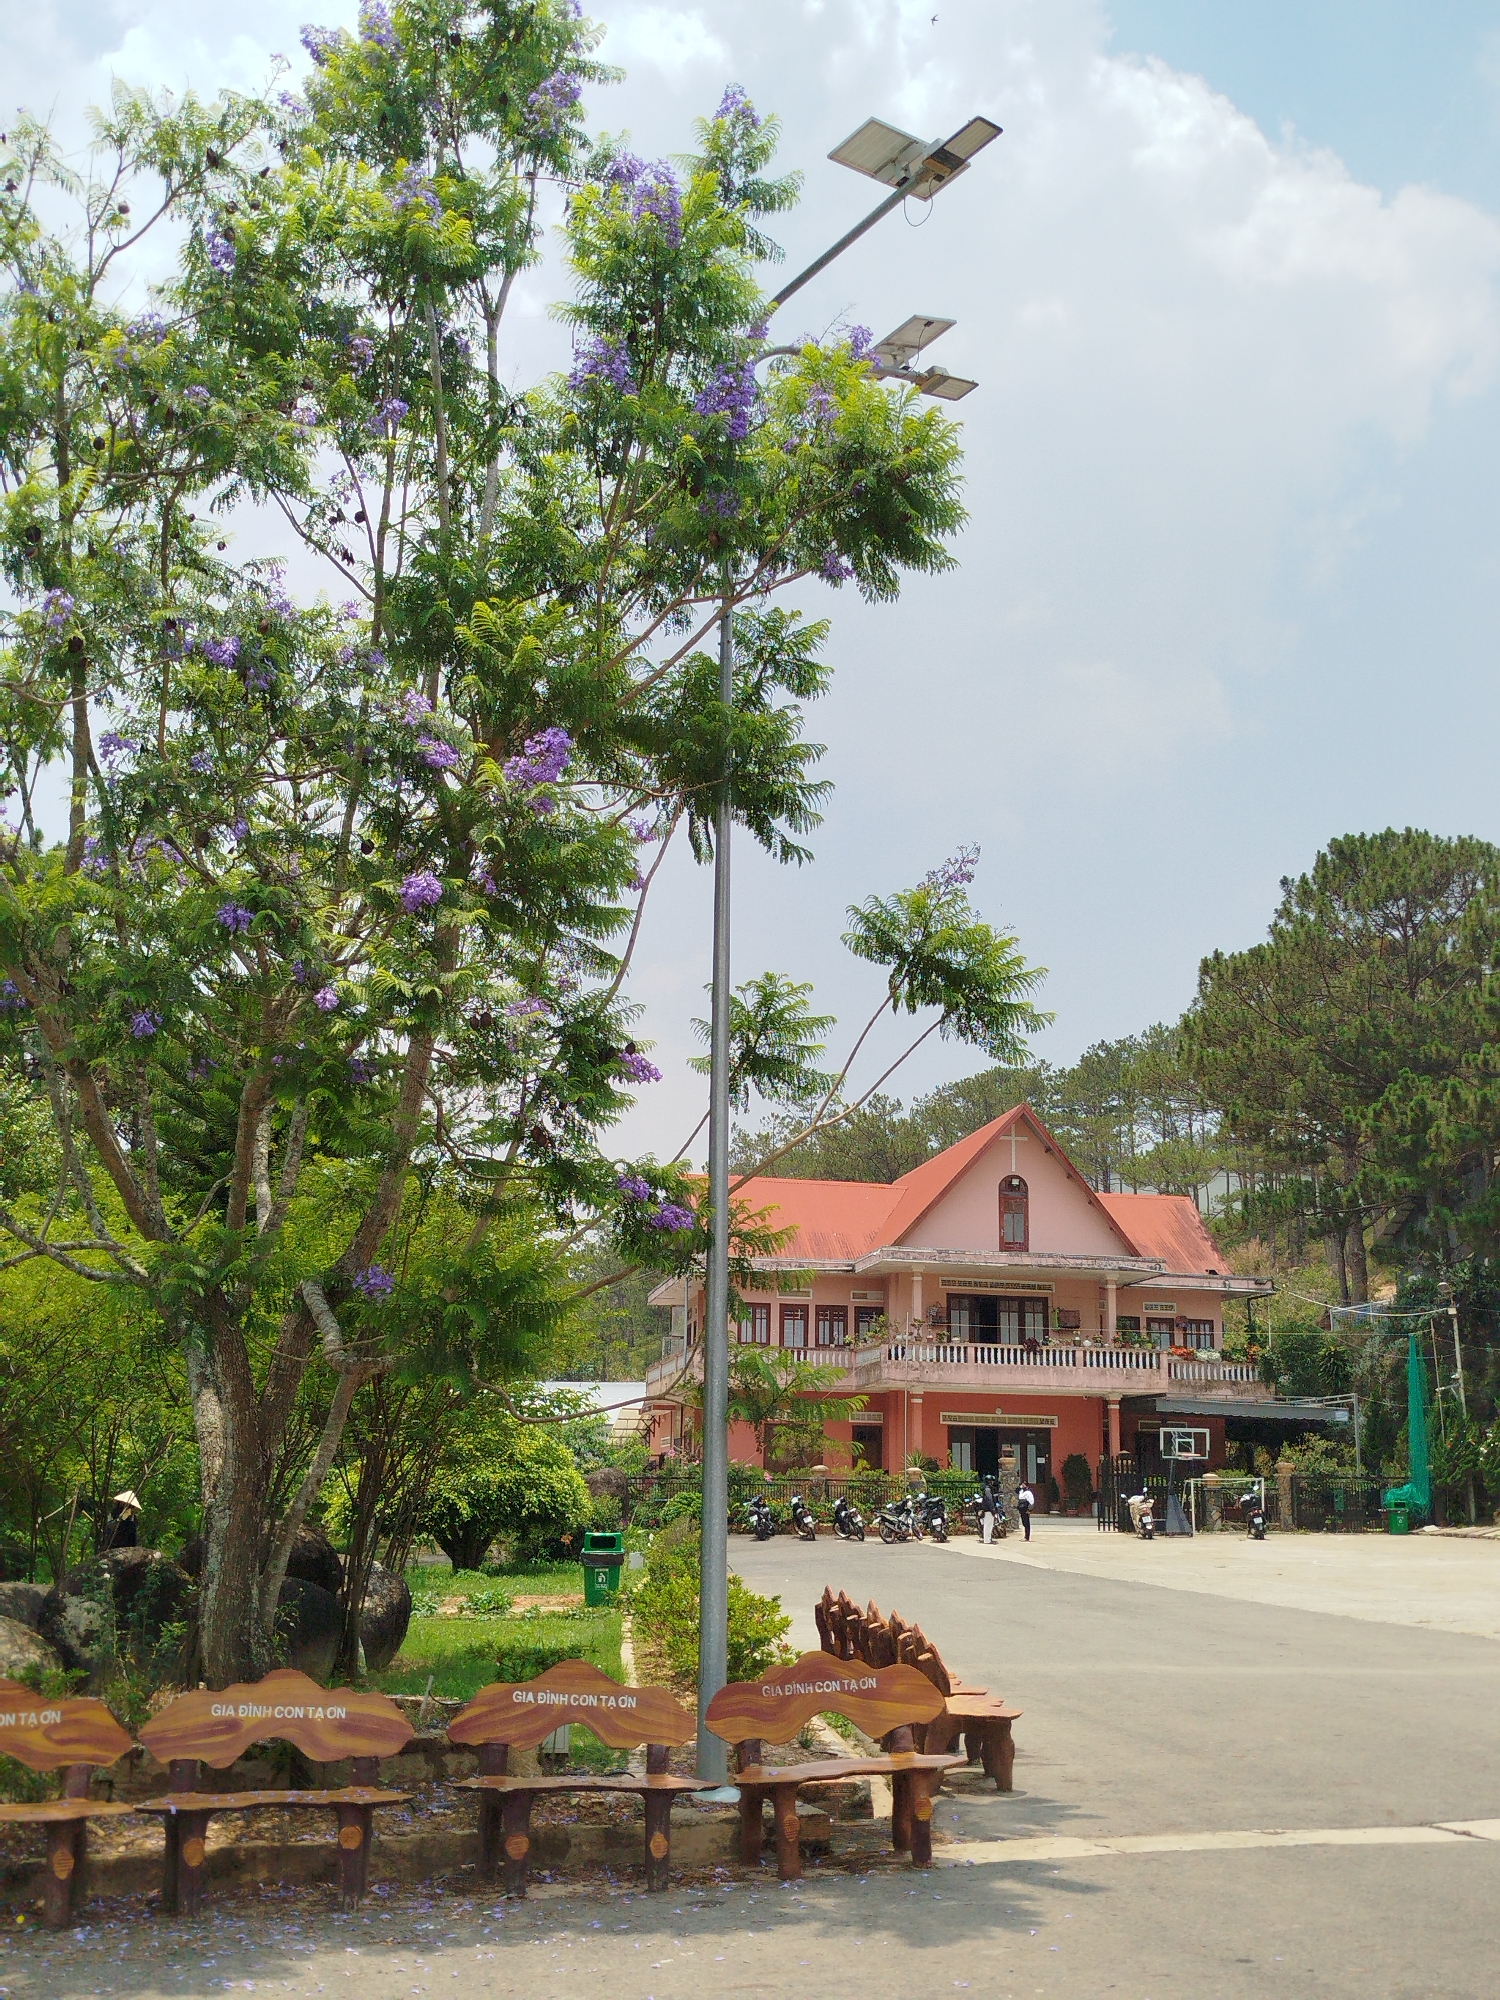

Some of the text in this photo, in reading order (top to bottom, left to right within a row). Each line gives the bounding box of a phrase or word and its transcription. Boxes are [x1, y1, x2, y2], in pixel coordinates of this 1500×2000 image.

[762, 1677, 877, 1697] GIA ĐÌNH CON TẠ ƠN
[512, 1690, 637, 1709] GIA ĐÌNH CON TẠ ƠN
[18, 1712, 38, 1728] TẠ
[40, 1710, 62, 1725] ƠN
[211, 1702, 347, 1721] GIA ĐÌNH CON TẠ ƠN
